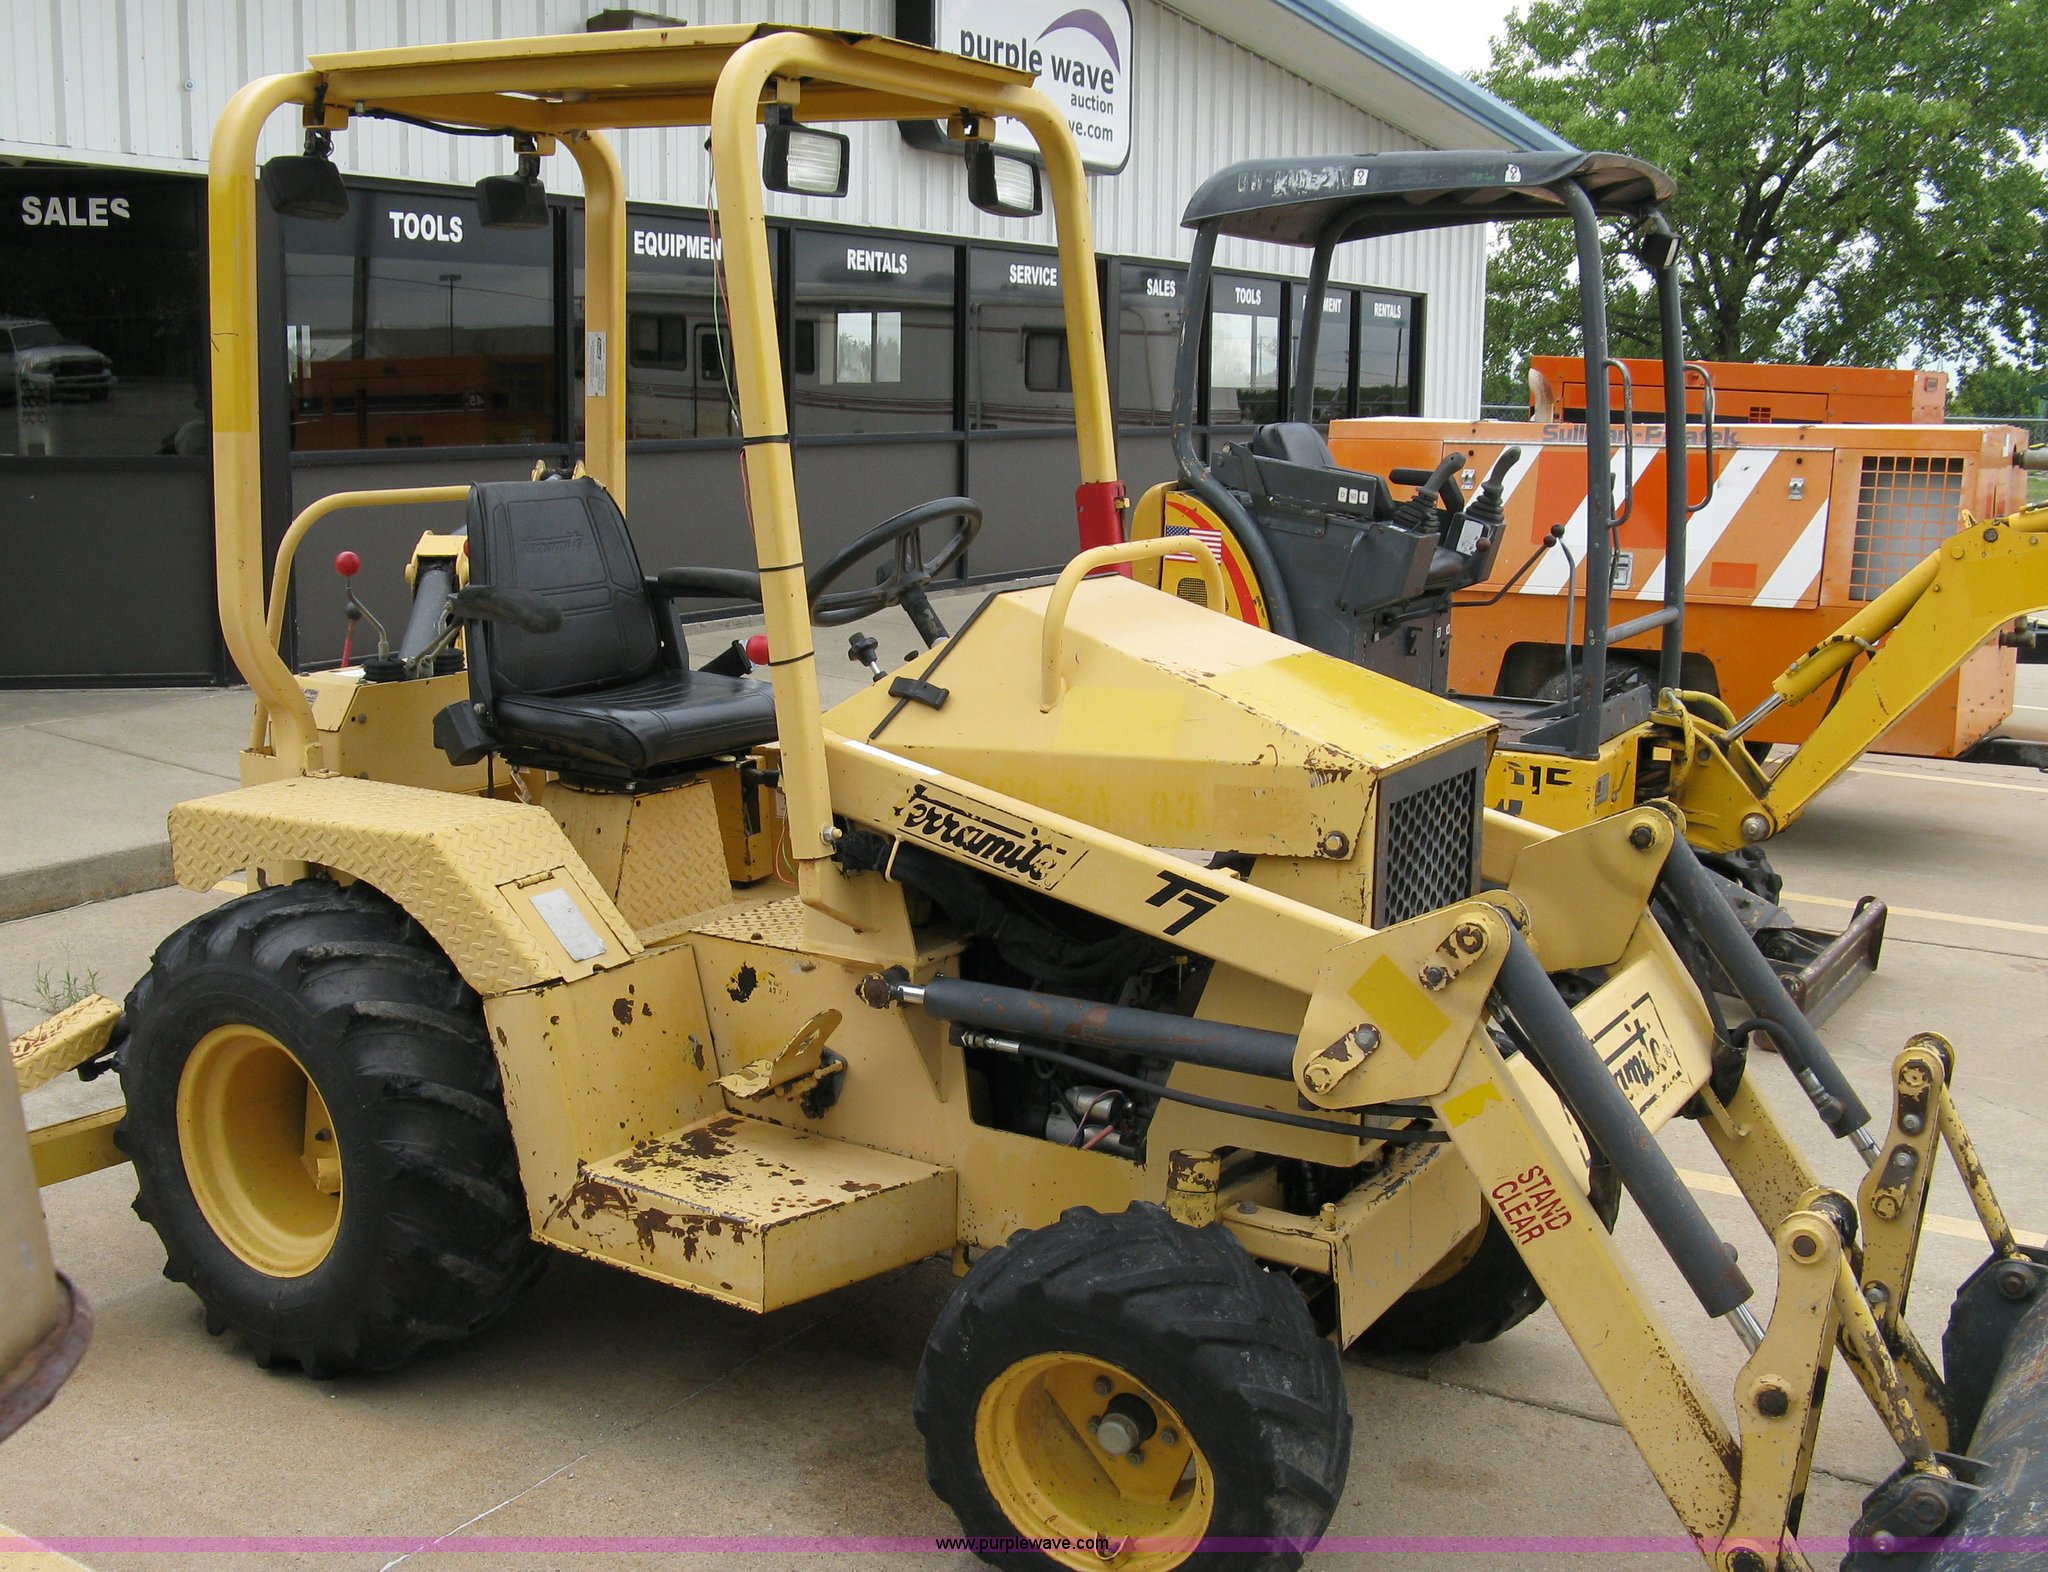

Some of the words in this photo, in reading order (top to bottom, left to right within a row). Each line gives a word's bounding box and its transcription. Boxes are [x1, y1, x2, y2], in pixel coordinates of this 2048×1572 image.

[960, 29, 1042, 76] purple
[1051, 54, 1114, 95] wave
[1070, 91, 1113, 116] auction
[21, 196, 131, 226] SALES
[389, 211, 463, 243] TOOLS
[634, 230, 722, 261] EQUIPMEN
[847, 248, 908, 275] RENTALS
[1009, 263, 1058, 287] SERVICE
[1146, 278, 1176, 298] SALES
[1235, 287, 1262, 305] TOOLS
[1373, 302, 1402, 319] RENTALS
[1517, 1165, 1572, 1232] STAND
[1491, 1180, 1545, 1246] CLEAR
